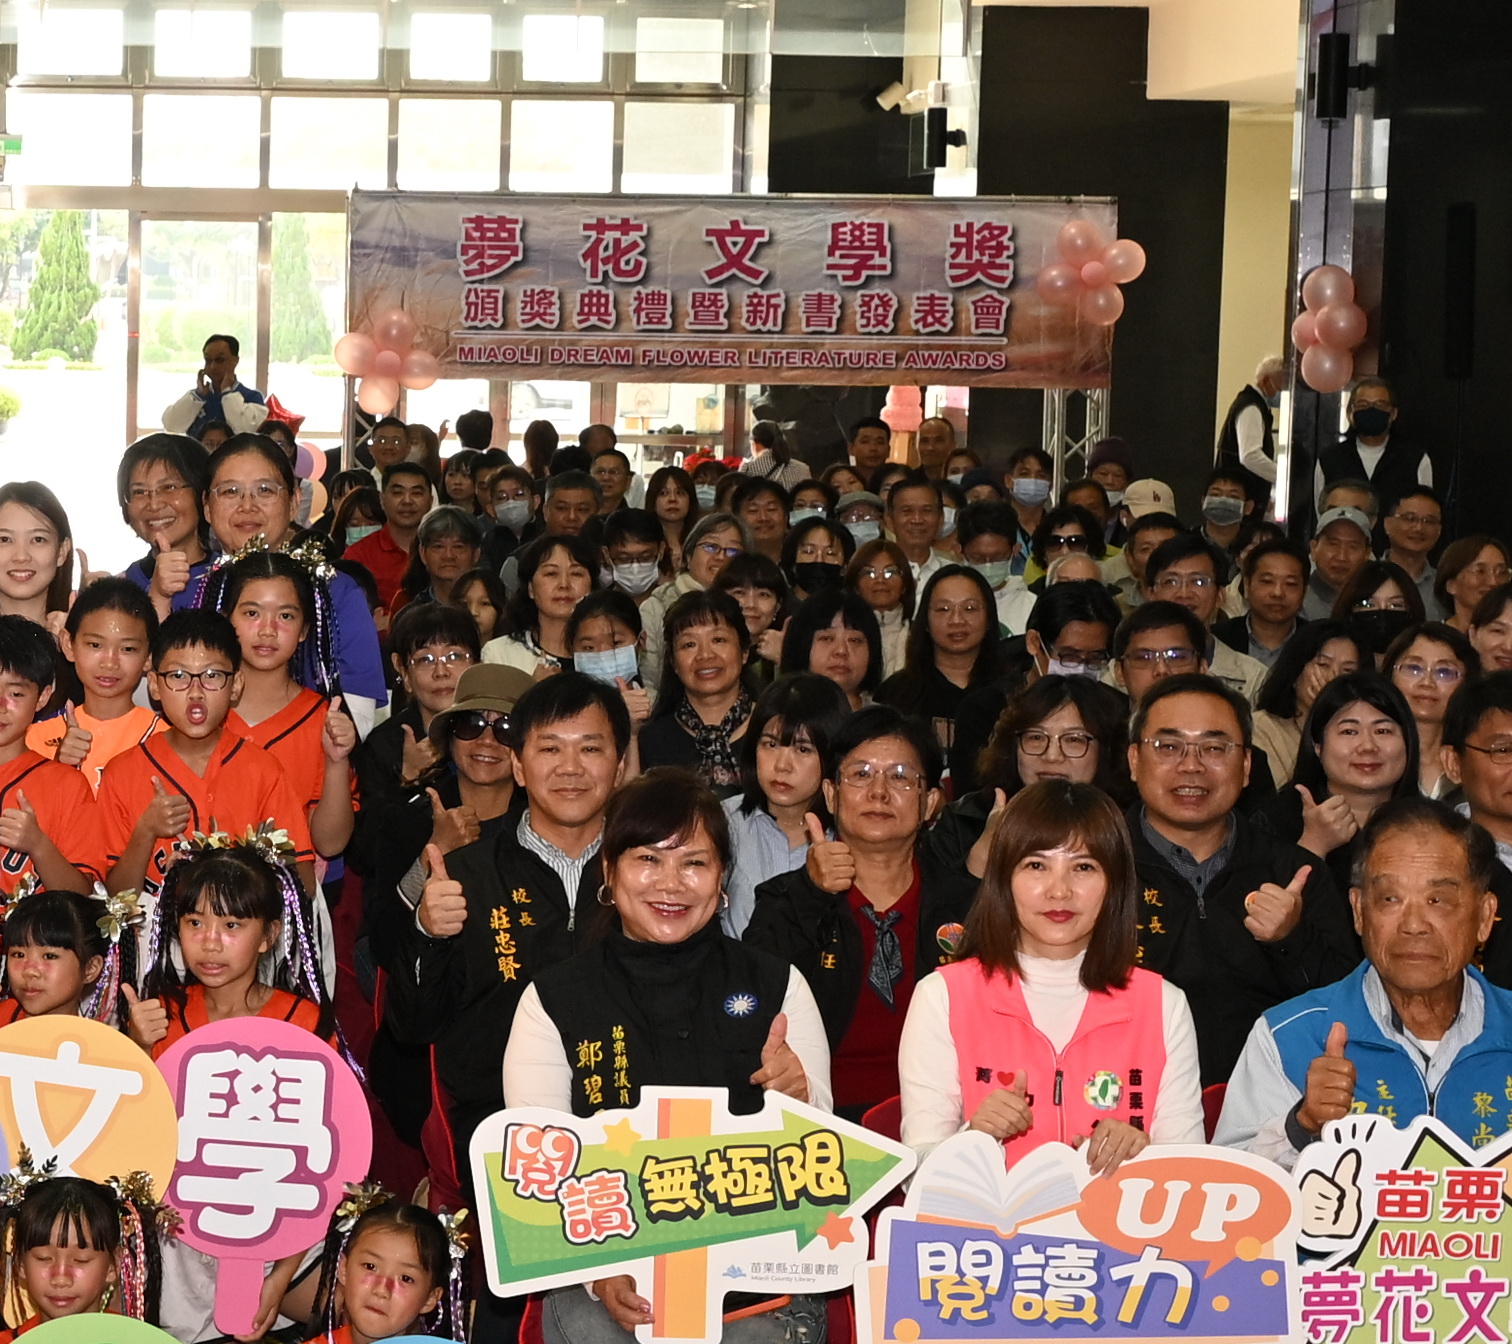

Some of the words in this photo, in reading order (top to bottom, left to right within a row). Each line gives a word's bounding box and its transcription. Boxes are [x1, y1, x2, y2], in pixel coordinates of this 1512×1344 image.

[460, 214, 1012, 285] 夢花文學獎
[462, 290, 1009, 333] 頒獎典禮暨新書發表會
[457, 345, 540, 364] MIAOLI
[549, 346, 633, 366] DREAM
[641, 347, 739, 367] FLOWER
[747, 348, 895, 369] LITERATURE
[905, 350, 1006, 371] AWARDS
[511, 887, 537, 927] 校長
[490, 905, 522, 983] 莊忠賢
[576, 1039, 606, 1114] 鄭碧
[178, 1048, 330, 1238] 學
[503, 1122, 852, 1244] 閱讀無極限
[1114, 1177, 1248, 1244] UP
[750, 1262, 839, 1276] 苗栗縣立圖書館
[1378, 1231, 1501, 1260] MIAOLI
[917, 1238, 1195, 1326] 閱讀力
